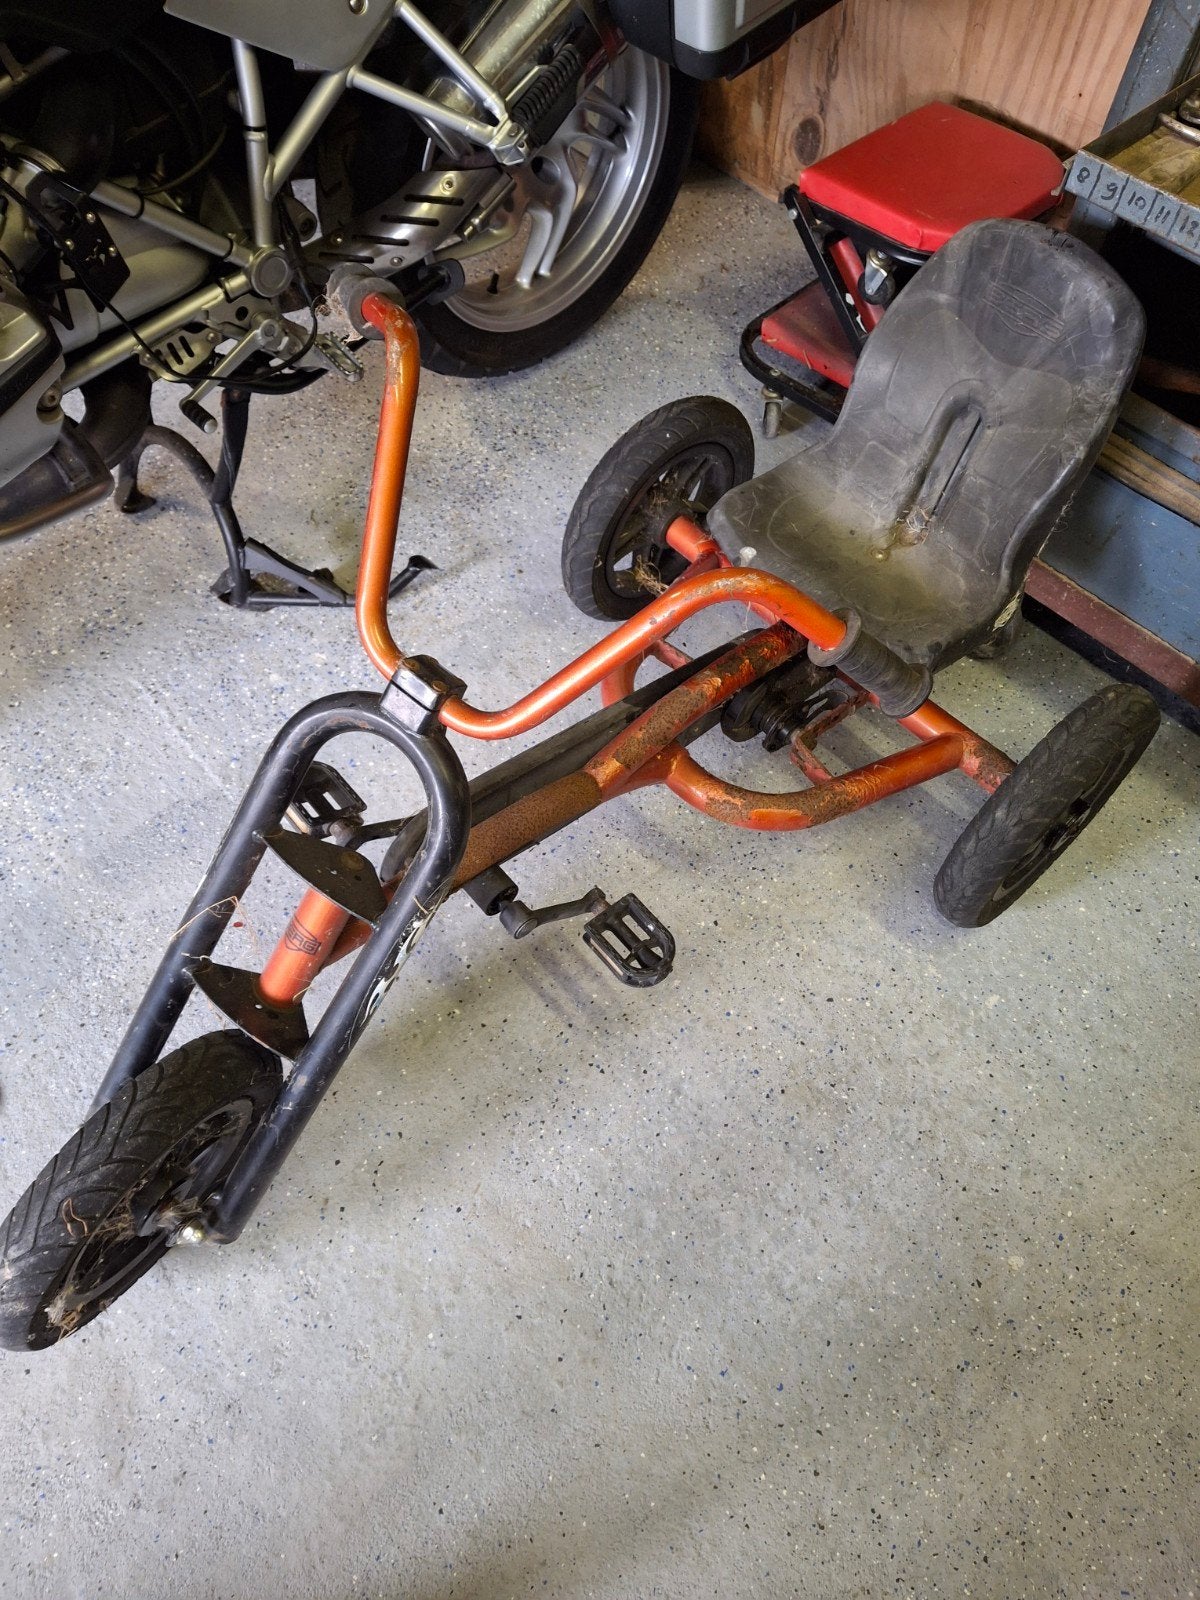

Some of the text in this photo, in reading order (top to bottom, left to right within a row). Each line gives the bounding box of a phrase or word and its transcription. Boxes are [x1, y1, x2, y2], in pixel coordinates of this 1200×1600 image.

[1076, 166, 1091, 183] 8
[1100, 182, 1119, 200] 9
[1127, 191, 1147, 210] 10
[1154, 205, 1171, 224] 11
[286, 923, 318, 952] ERG
